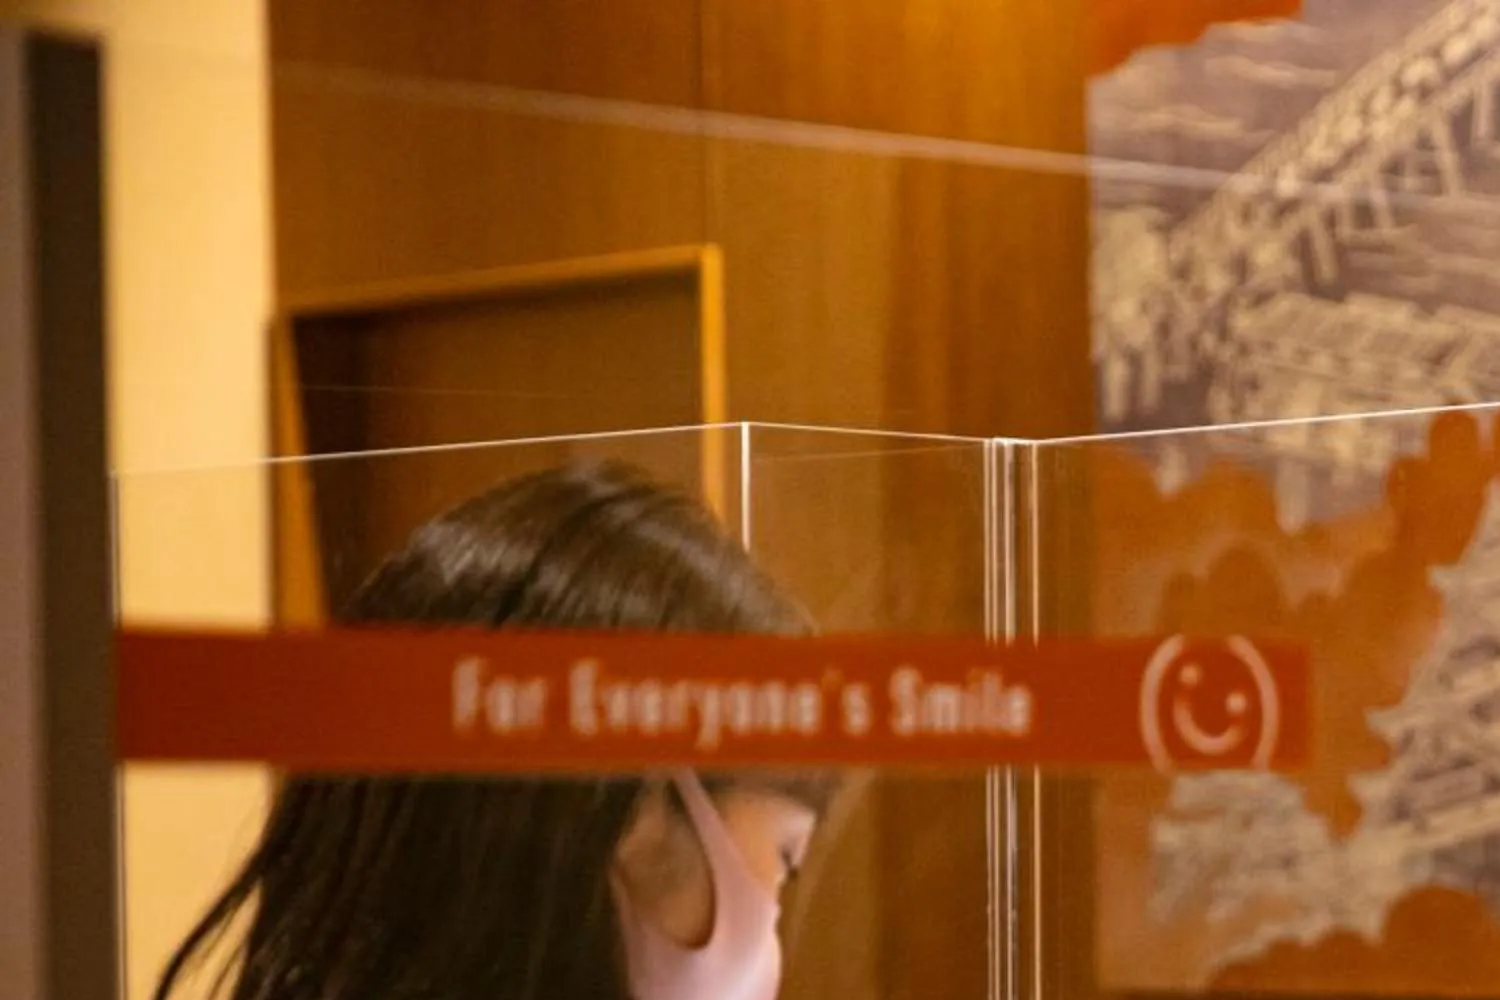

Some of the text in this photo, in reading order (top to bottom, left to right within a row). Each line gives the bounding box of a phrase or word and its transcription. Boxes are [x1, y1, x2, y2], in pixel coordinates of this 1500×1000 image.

[451, 658, 1034, 751] For Everyone's Smile
